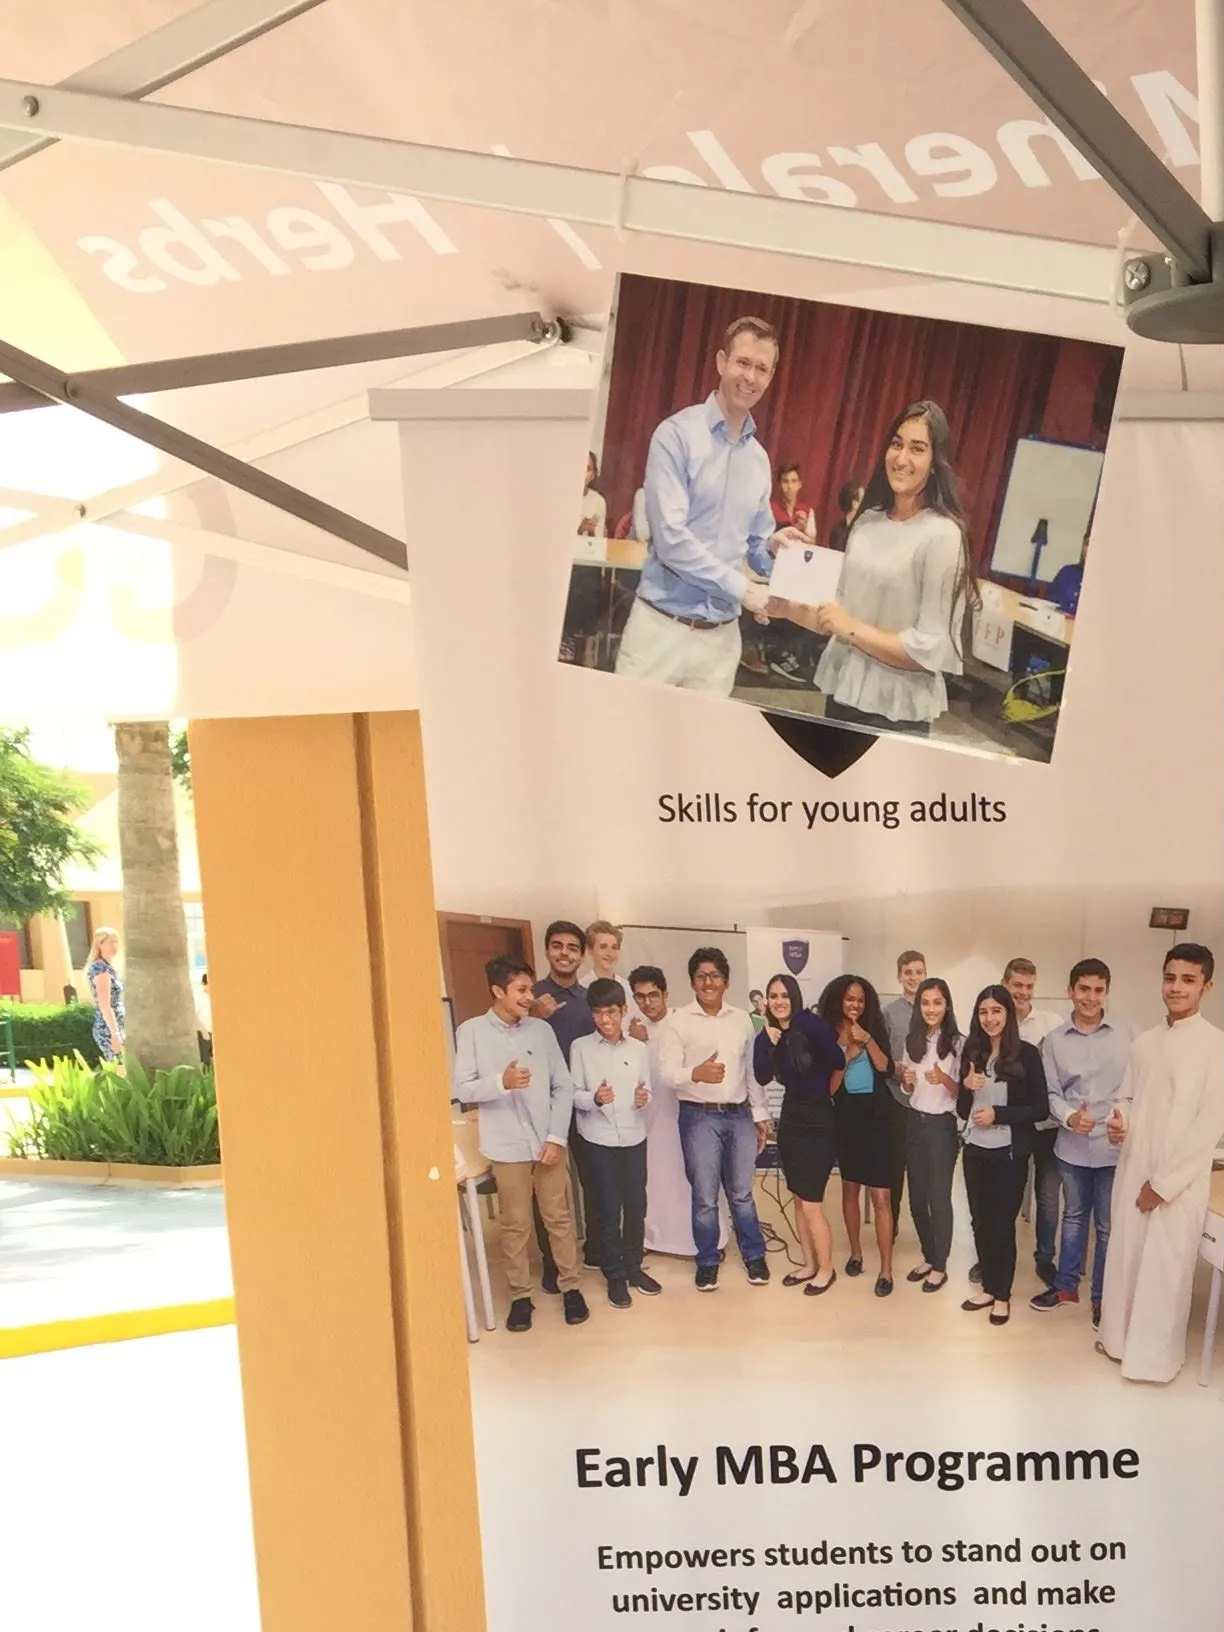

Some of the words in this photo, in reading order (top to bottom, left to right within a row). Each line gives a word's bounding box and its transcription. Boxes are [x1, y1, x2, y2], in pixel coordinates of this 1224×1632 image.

[658, 792, 737, 823] Skills
[746, 792, 793, 823] for
[801, 801, 900, 830] young
[910, 792, 1007, 823] adults
[576, 1444, 699, 1497] Early
[715, 1444, 838, 1486] MBA
[853, 1443, 1140, 1492] Programme
[598, 1545, 756, 1575] Empowers
[764, 1540, 893, 1566] students
[901, 1541, 933, 1564] to
[941, 1537, 1021, 1563] stand
[1031, 1539, 1081, 1563] out
[1089, 1541, 1126, 1561] on
[612, 1585, 760, 1616] university
[777, 1581, 957, 1615] applications
[973, 1580, 1027, 1606] and
[1037, 1579, 1116, 1606] make
